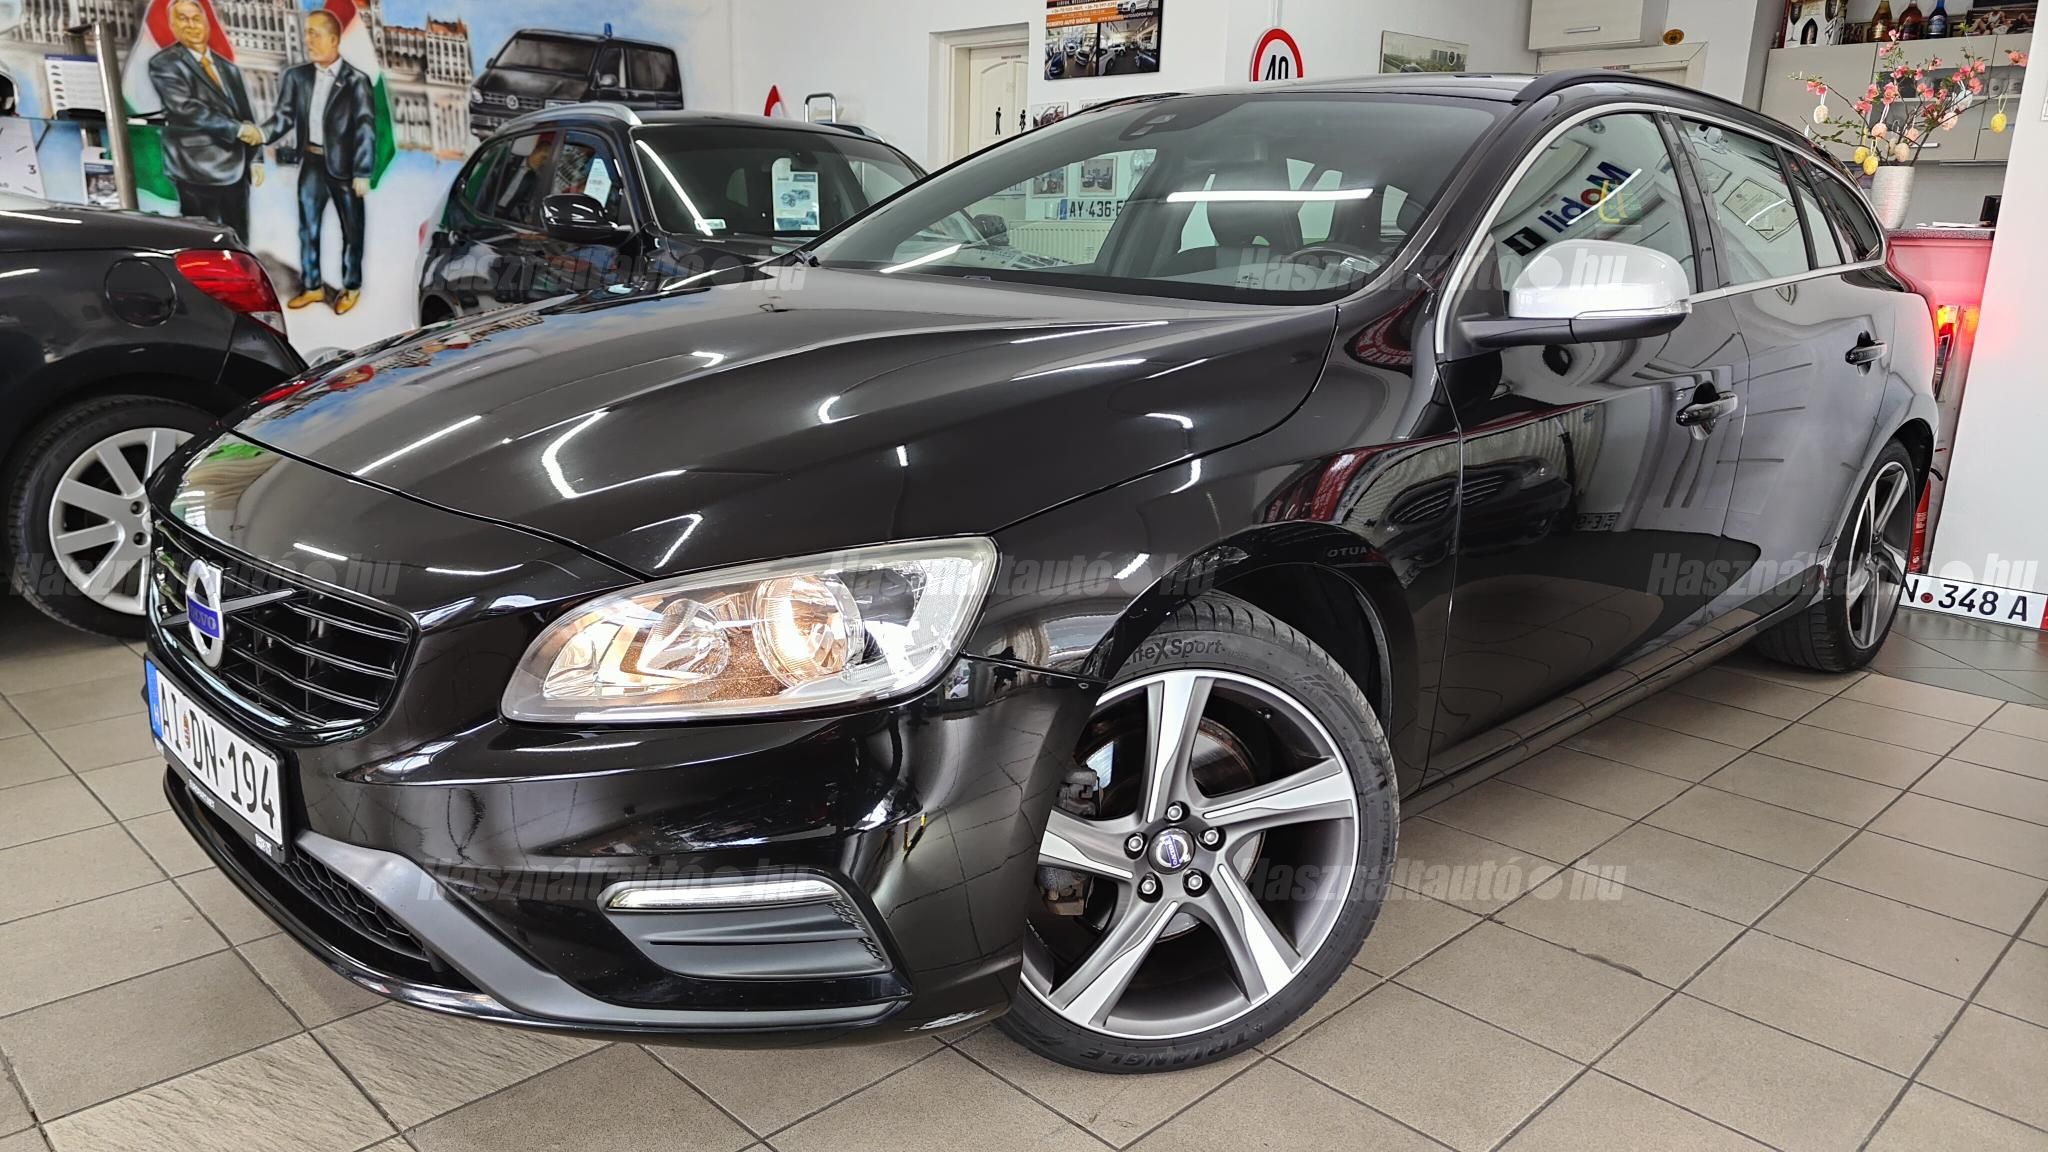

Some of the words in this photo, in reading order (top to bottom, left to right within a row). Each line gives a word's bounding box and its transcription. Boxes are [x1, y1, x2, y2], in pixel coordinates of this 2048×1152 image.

[1938, 583, 1999, 616] 348
[2007, 595, 2027, 622] A
[160, 682, 183, 753] AI
[189, 708, 275, 831] DN-194
